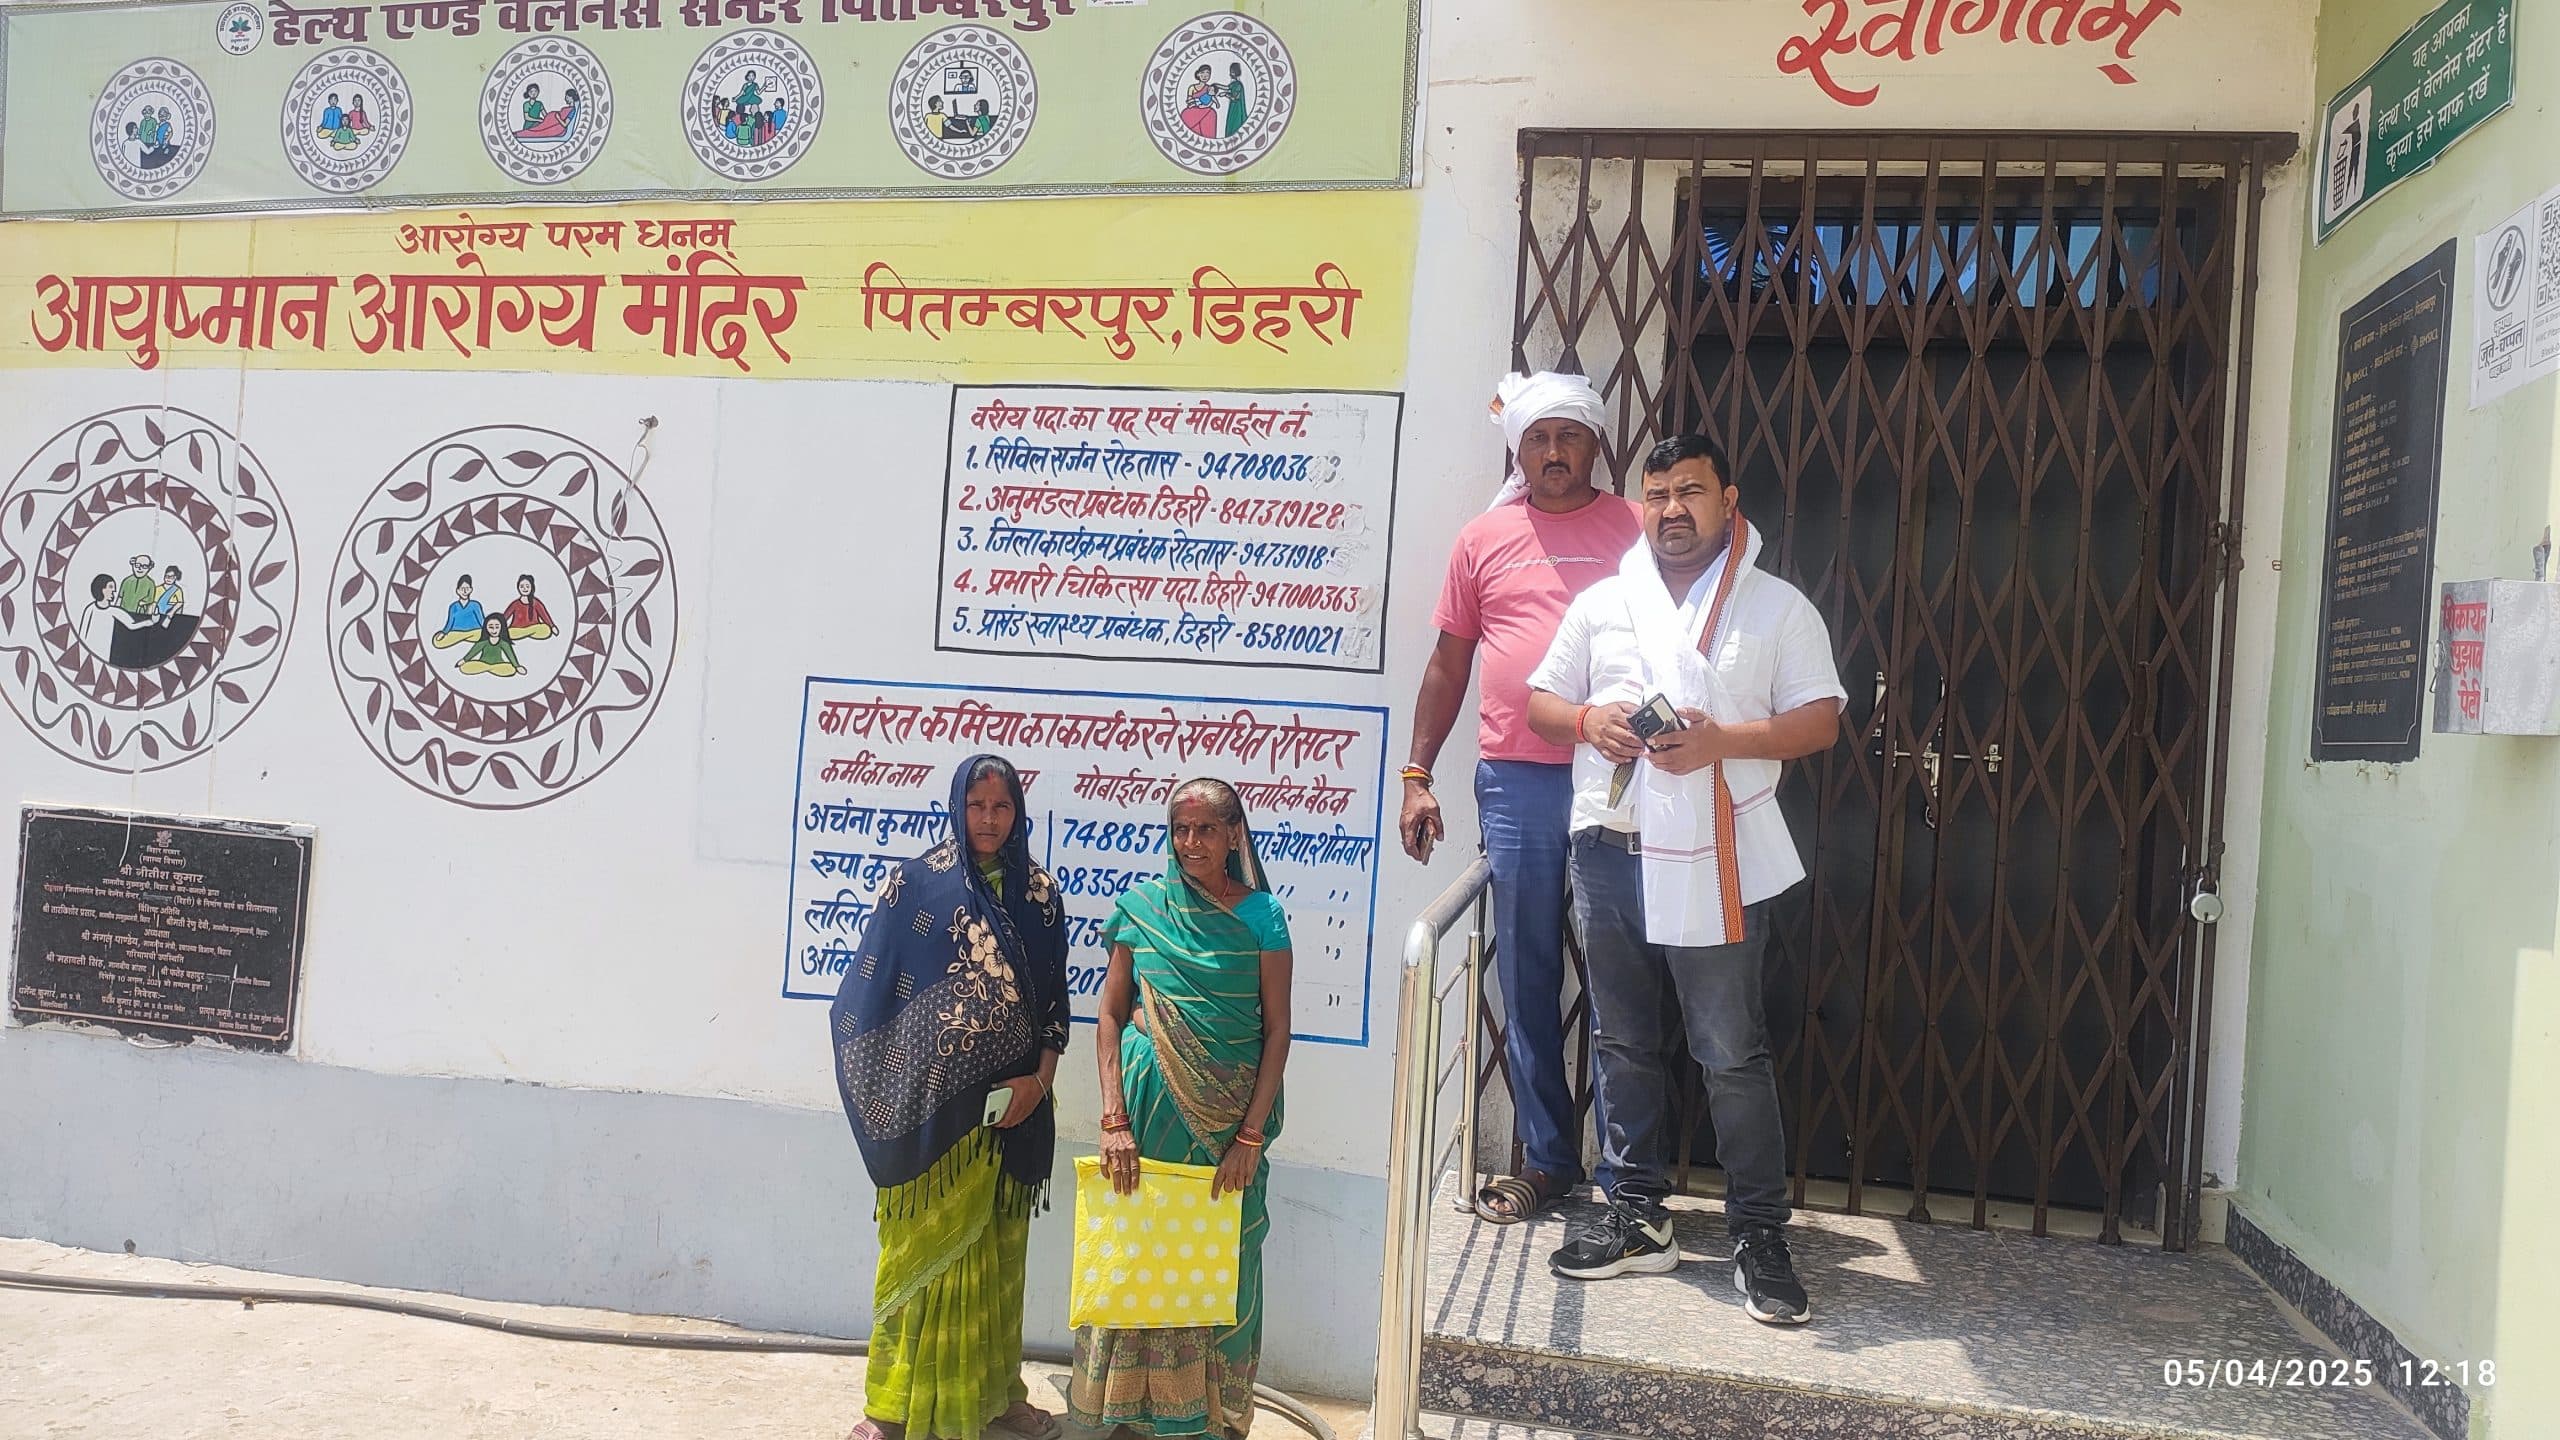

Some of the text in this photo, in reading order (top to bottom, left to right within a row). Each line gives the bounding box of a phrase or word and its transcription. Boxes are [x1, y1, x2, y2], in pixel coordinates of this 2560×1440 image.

[2412, 3, 2472, 68] यह आपका
[2402, 79, 2422, 122] एवं
[2423, 52, 2463, 99] वेलनेस
[2465, 31, 2494, 68] सेंटर
[2497, 6, 2508, 44] है
[2416, 110, 2435, 151] इसे
[2437, 92, 2465, 130] साफ
[2468, 63, 2491, 106] रखें
[395, 212, 738, 260] आरोग्य परम धनम्
[30, 274, 340, 371] आयुष्मान
[351, 253, 607, 359] आरोग्य
[621, 251, 808, 372] मंदिर
[970, 399, 1032, 432] वरीय
[1106, 406, 1143, 440] पद
[1144, 401, 1184, 437] एवं
[985, 436, 1052, 475] सिविल
[1050, 440, 1102, 478] सर्जन
[1101, 439, 1183, 483] रोहतास
[958, 485, 982, 512] 2.
[985, 480, 1086, 524] अनुमंडल
[1078, 485, 1151, 520] प्रबंधक
[1149, 484, 1212, 529] डिहरी
[957, 526, 979, 552] 3.
[984, 516, 1046, 558] जिला
[1107, 528, 1173, 566] प्रबंधक
[1168, 528, 1239, 572] रोहतास
[953, 568, 978, 594] 4.
[984, 562, 1058, 604] प्रभारी
[1054, 565, 1164, 609] चिकित्सा
[1200, 570, 1253, 616] डिहरी
[952, 606, 972, 634] 5.
[1024, 612, 1103, 646] स्वास्थ्य
[1172, 611, 1237, 654] डिहरी
[818, 696, 923, 745] कार्यरत
[1177, 709, 1278, 766] संबंधित
[886, 762, 936, 789] नाम
[1303, 773, 1358, 817] बैठक
[804, 798, 878, 836] अर्चना
[172, 871, 204, 885] कुमार
